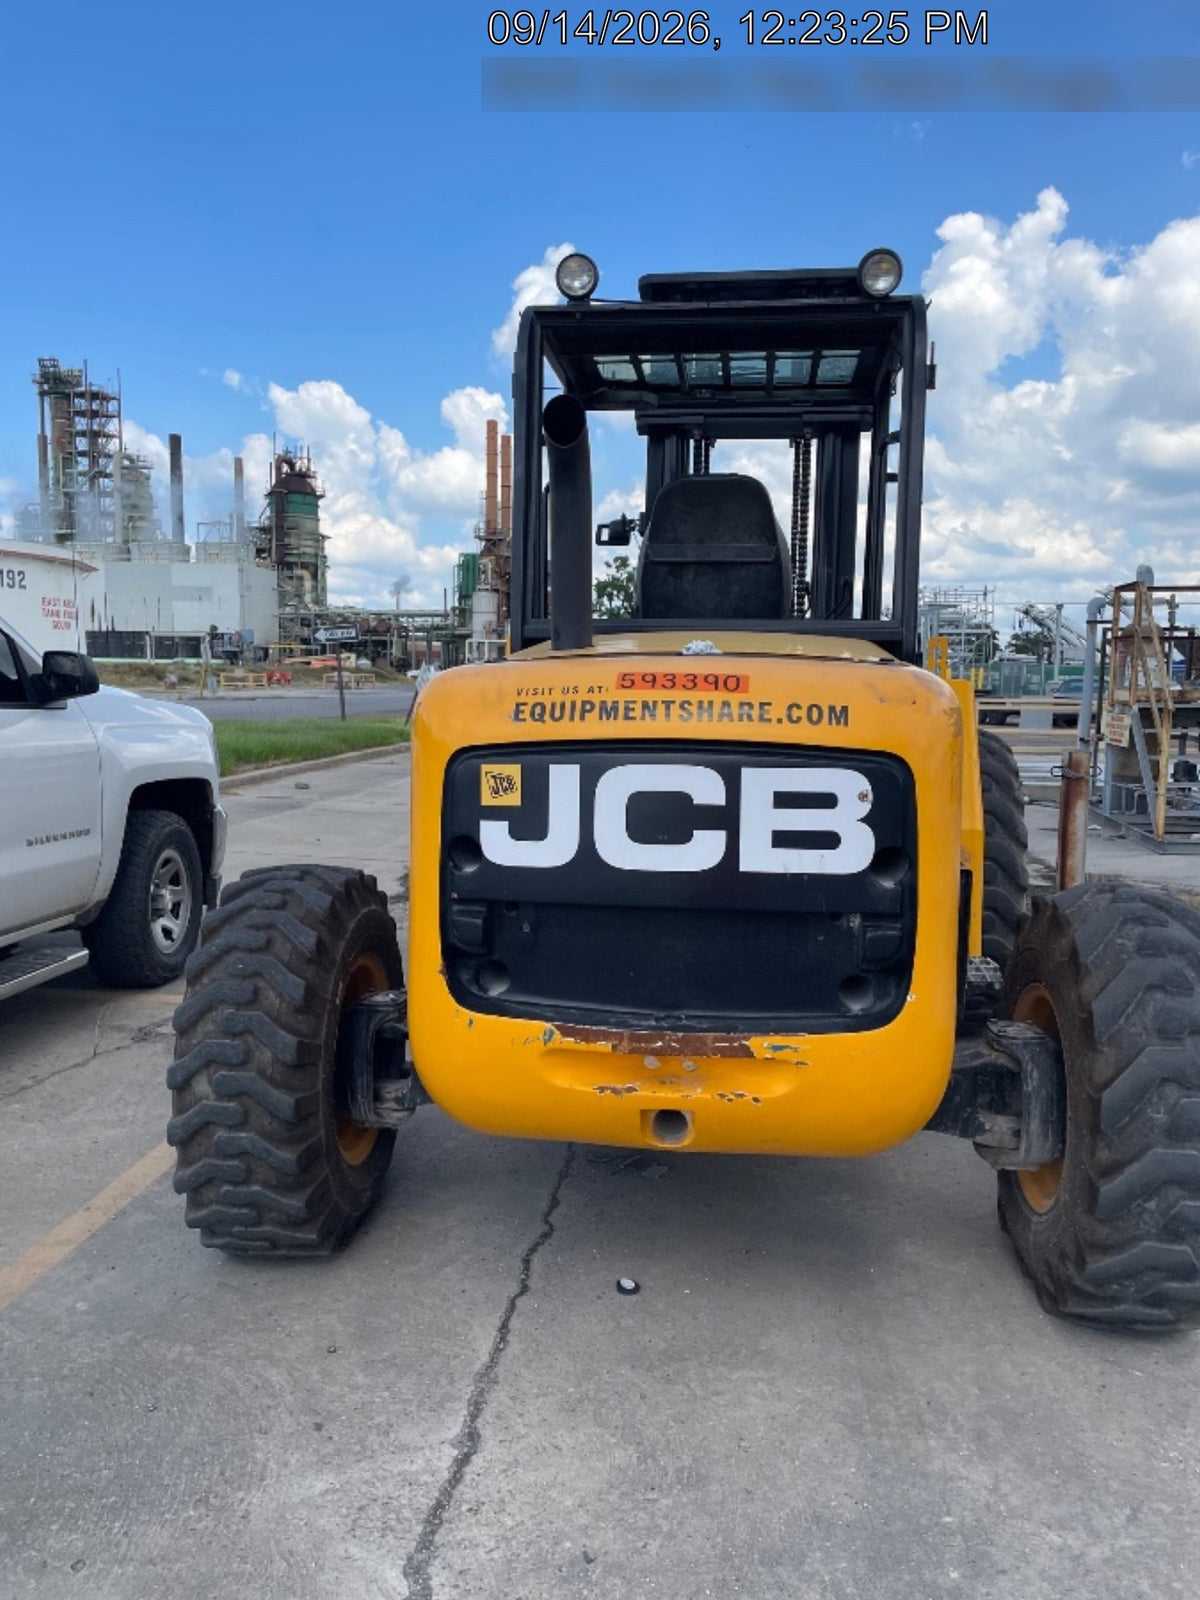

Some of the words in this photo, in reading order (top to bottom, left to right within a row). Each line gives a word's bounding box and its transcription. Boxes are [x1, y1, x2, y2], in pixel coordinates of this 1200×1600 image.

[516, 687, 554, 696] VISIT
[561, 685, 579, 695] US
[619, 672, 741, 692] 593390
[512, 699, 849, 727] EQUIPMENTSHARE.COM
[480, 764, 875, 874] JCB
